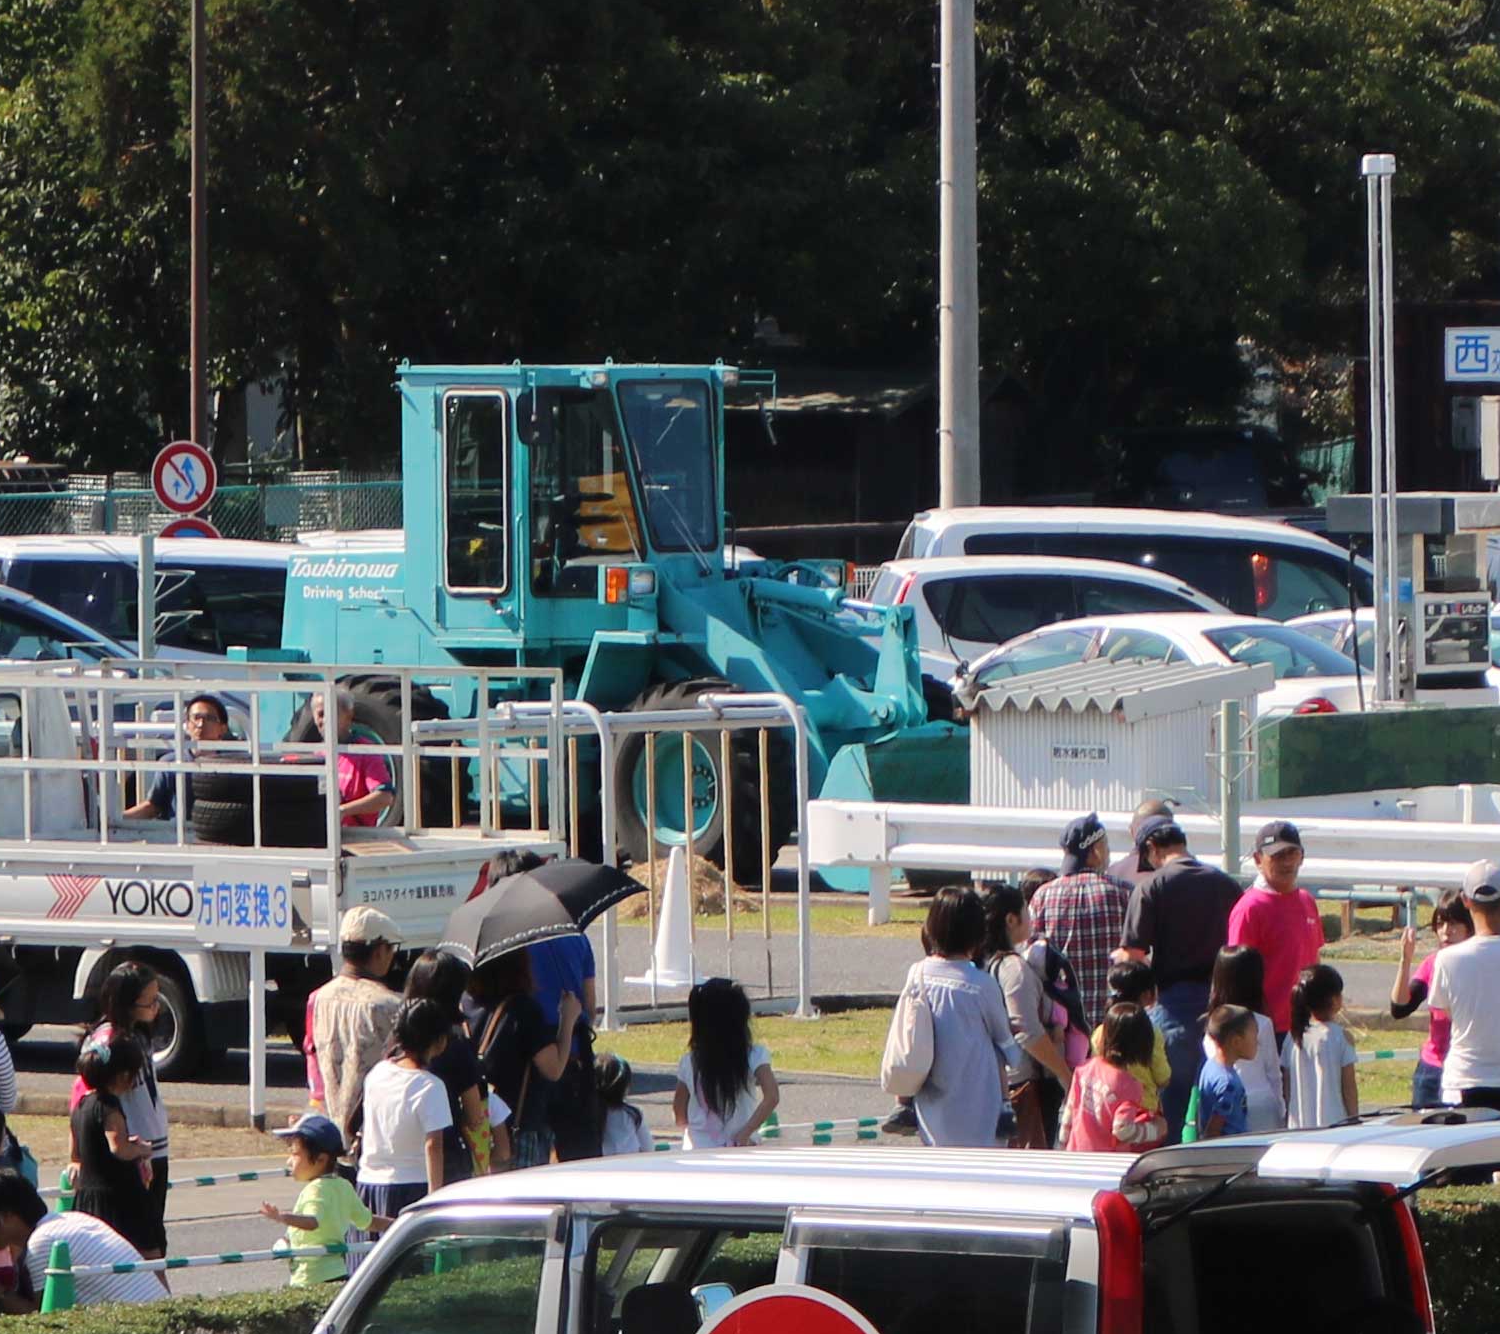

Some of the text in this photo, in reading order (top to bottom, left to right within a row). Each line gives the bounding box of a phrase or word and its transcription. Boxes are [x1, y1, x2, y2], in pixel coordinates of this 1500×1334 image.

[290, 557, 399, 579] Tsukinowa
[303, 585, 345, 602] Driving
[197, 880, 289, 929] 方向変換3
